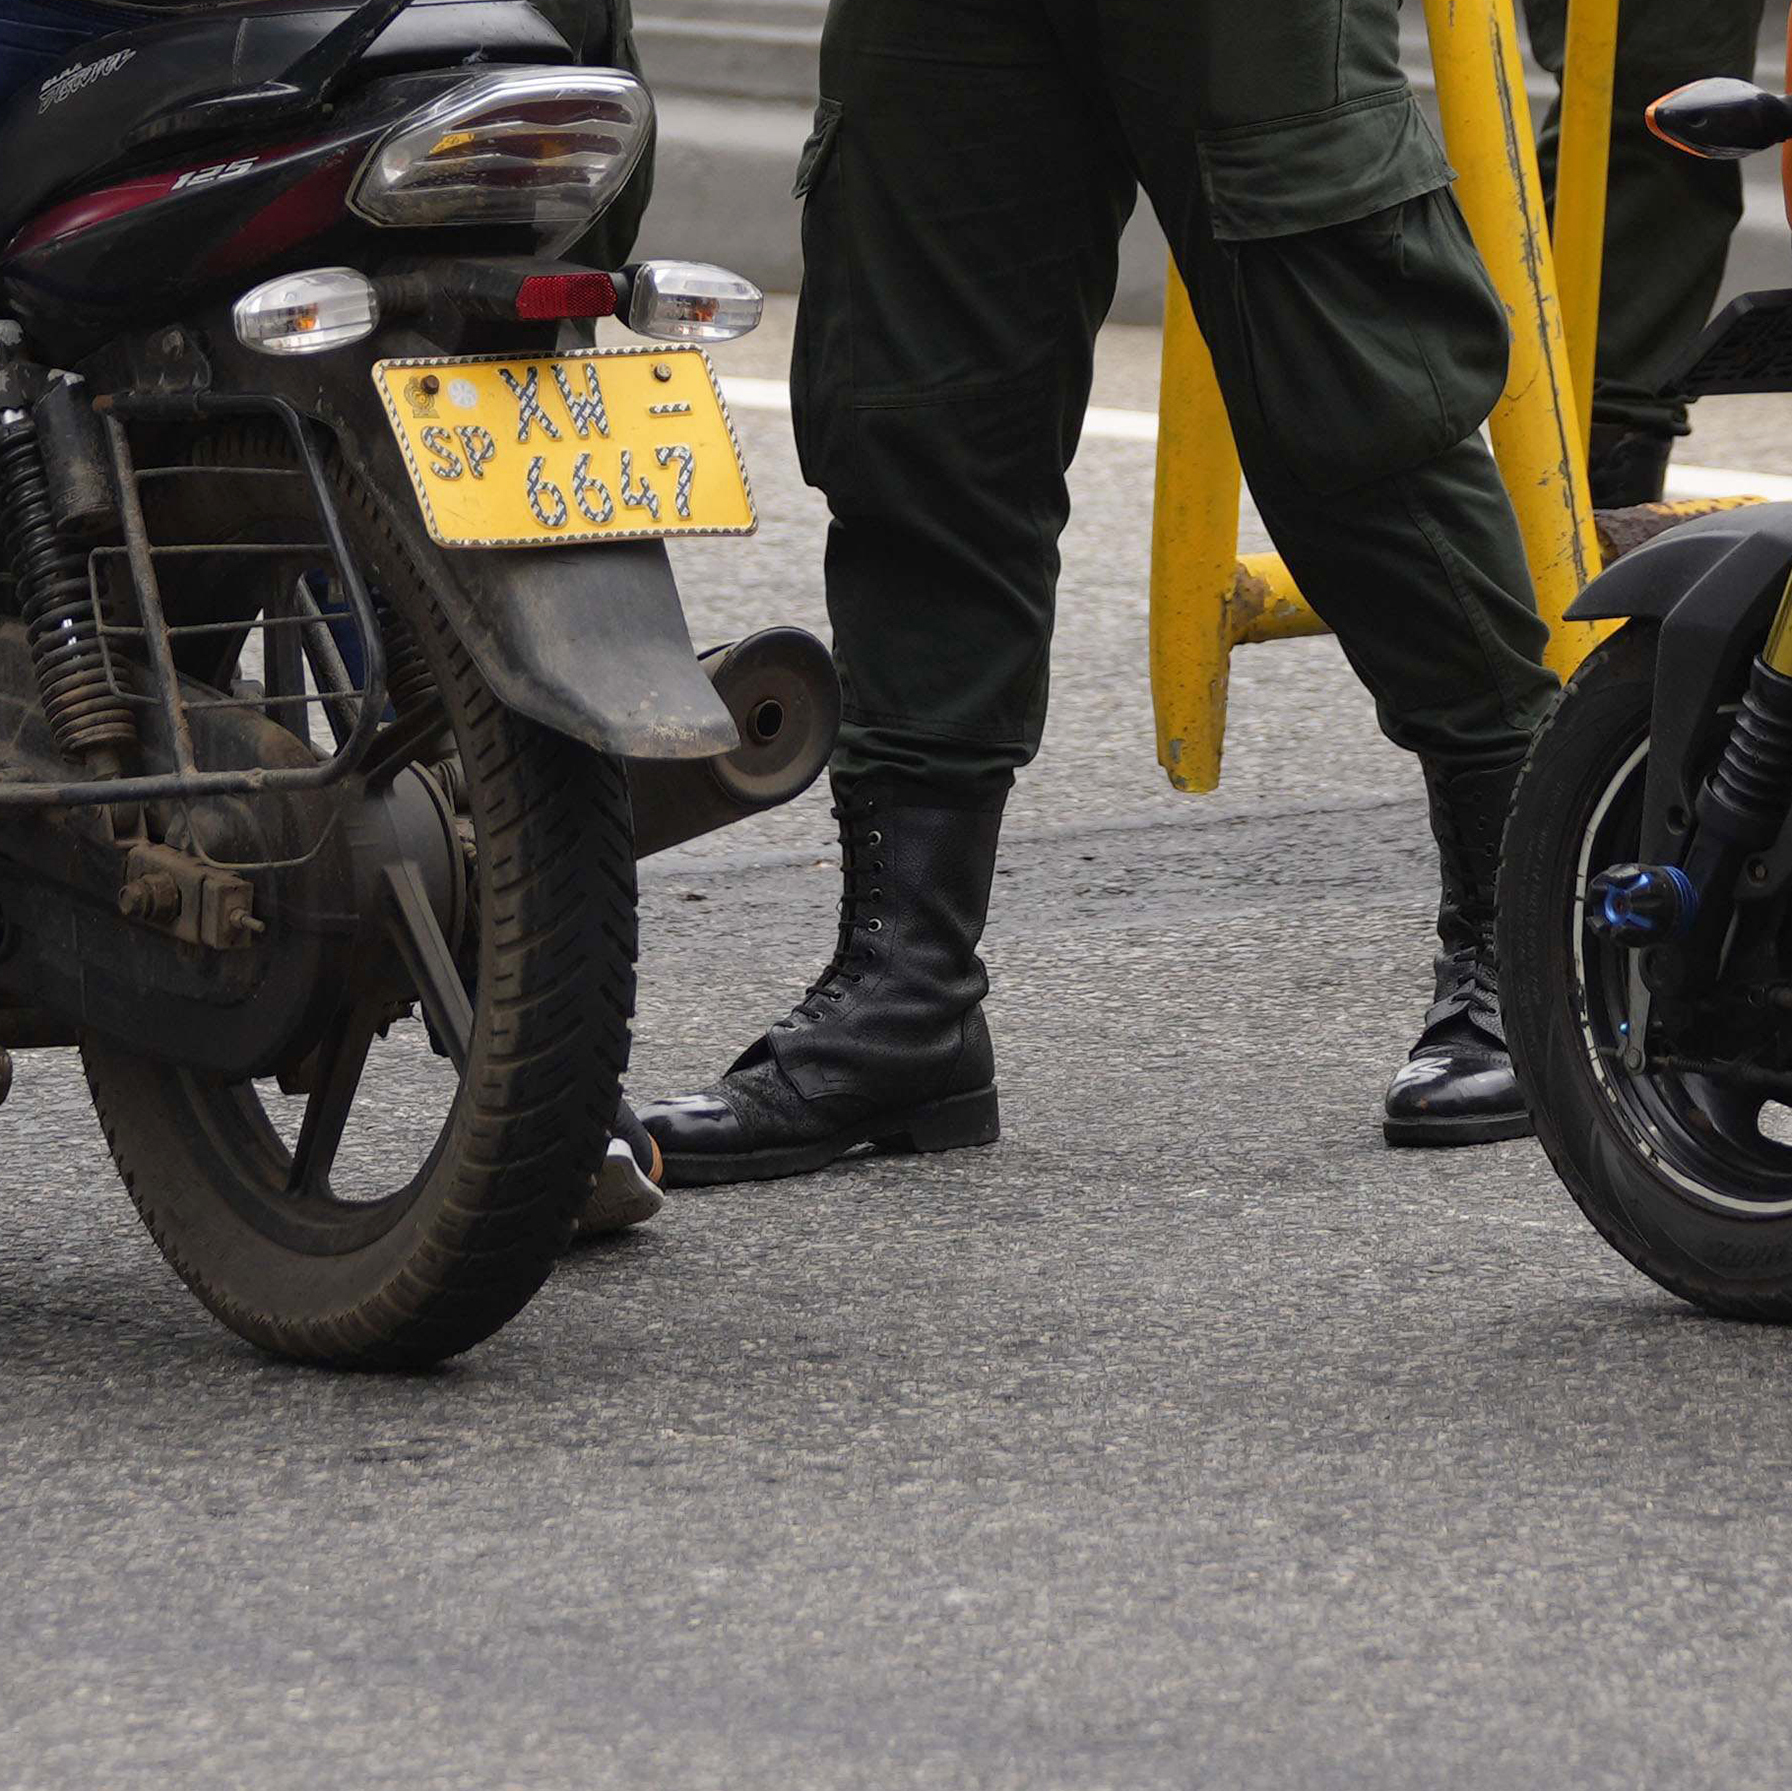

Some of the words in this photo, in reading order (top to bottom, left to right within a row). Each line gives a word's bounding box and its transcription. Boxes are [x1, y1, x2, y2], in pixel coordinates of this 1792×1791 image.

[171, 156, 260, 192] 125
[498, 362, 611, 444] XW
[420, 425, 497, 480] SP
[525, 444, 697, 529] 6647
